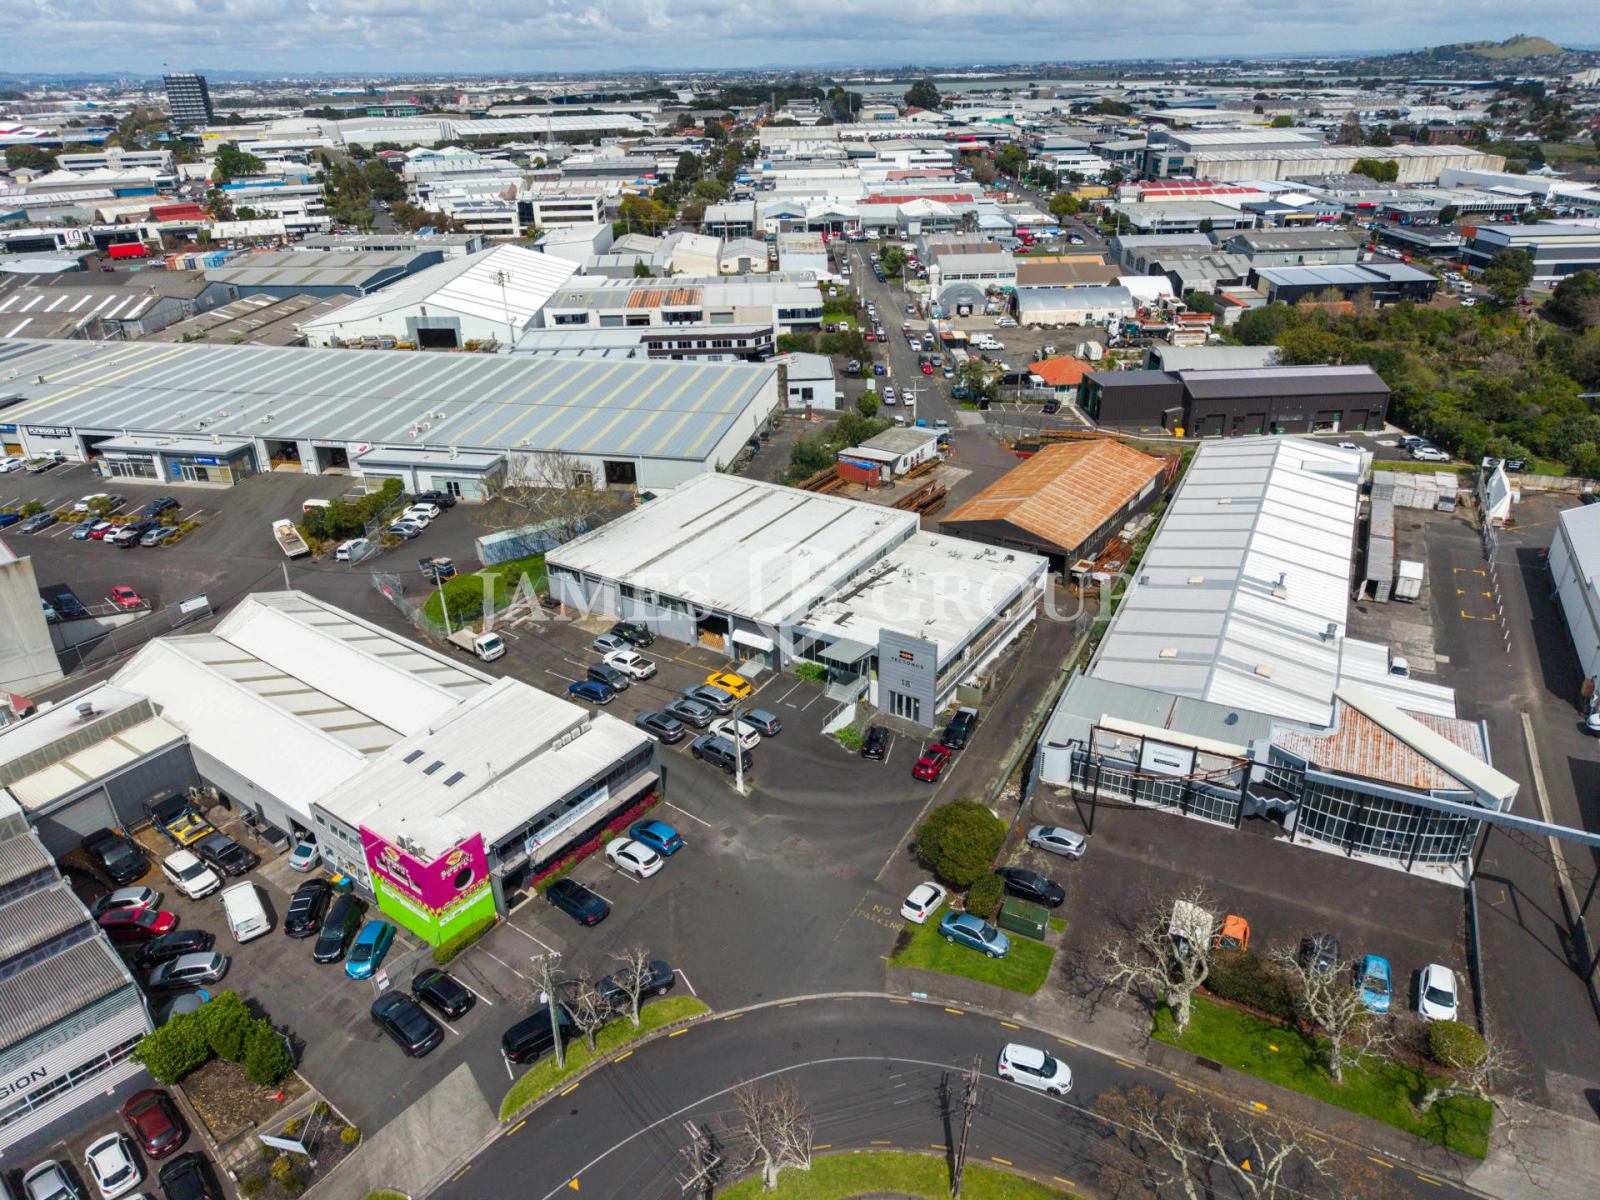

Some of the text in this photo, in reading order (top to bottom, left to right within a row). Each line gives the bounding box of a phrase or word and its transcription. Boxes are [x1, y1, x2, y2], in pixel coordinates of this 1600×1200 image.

[901, 680, 912, 688] 18
[872, 903, 893, 916] NO
[857, 910, 905, 931] PARKING
